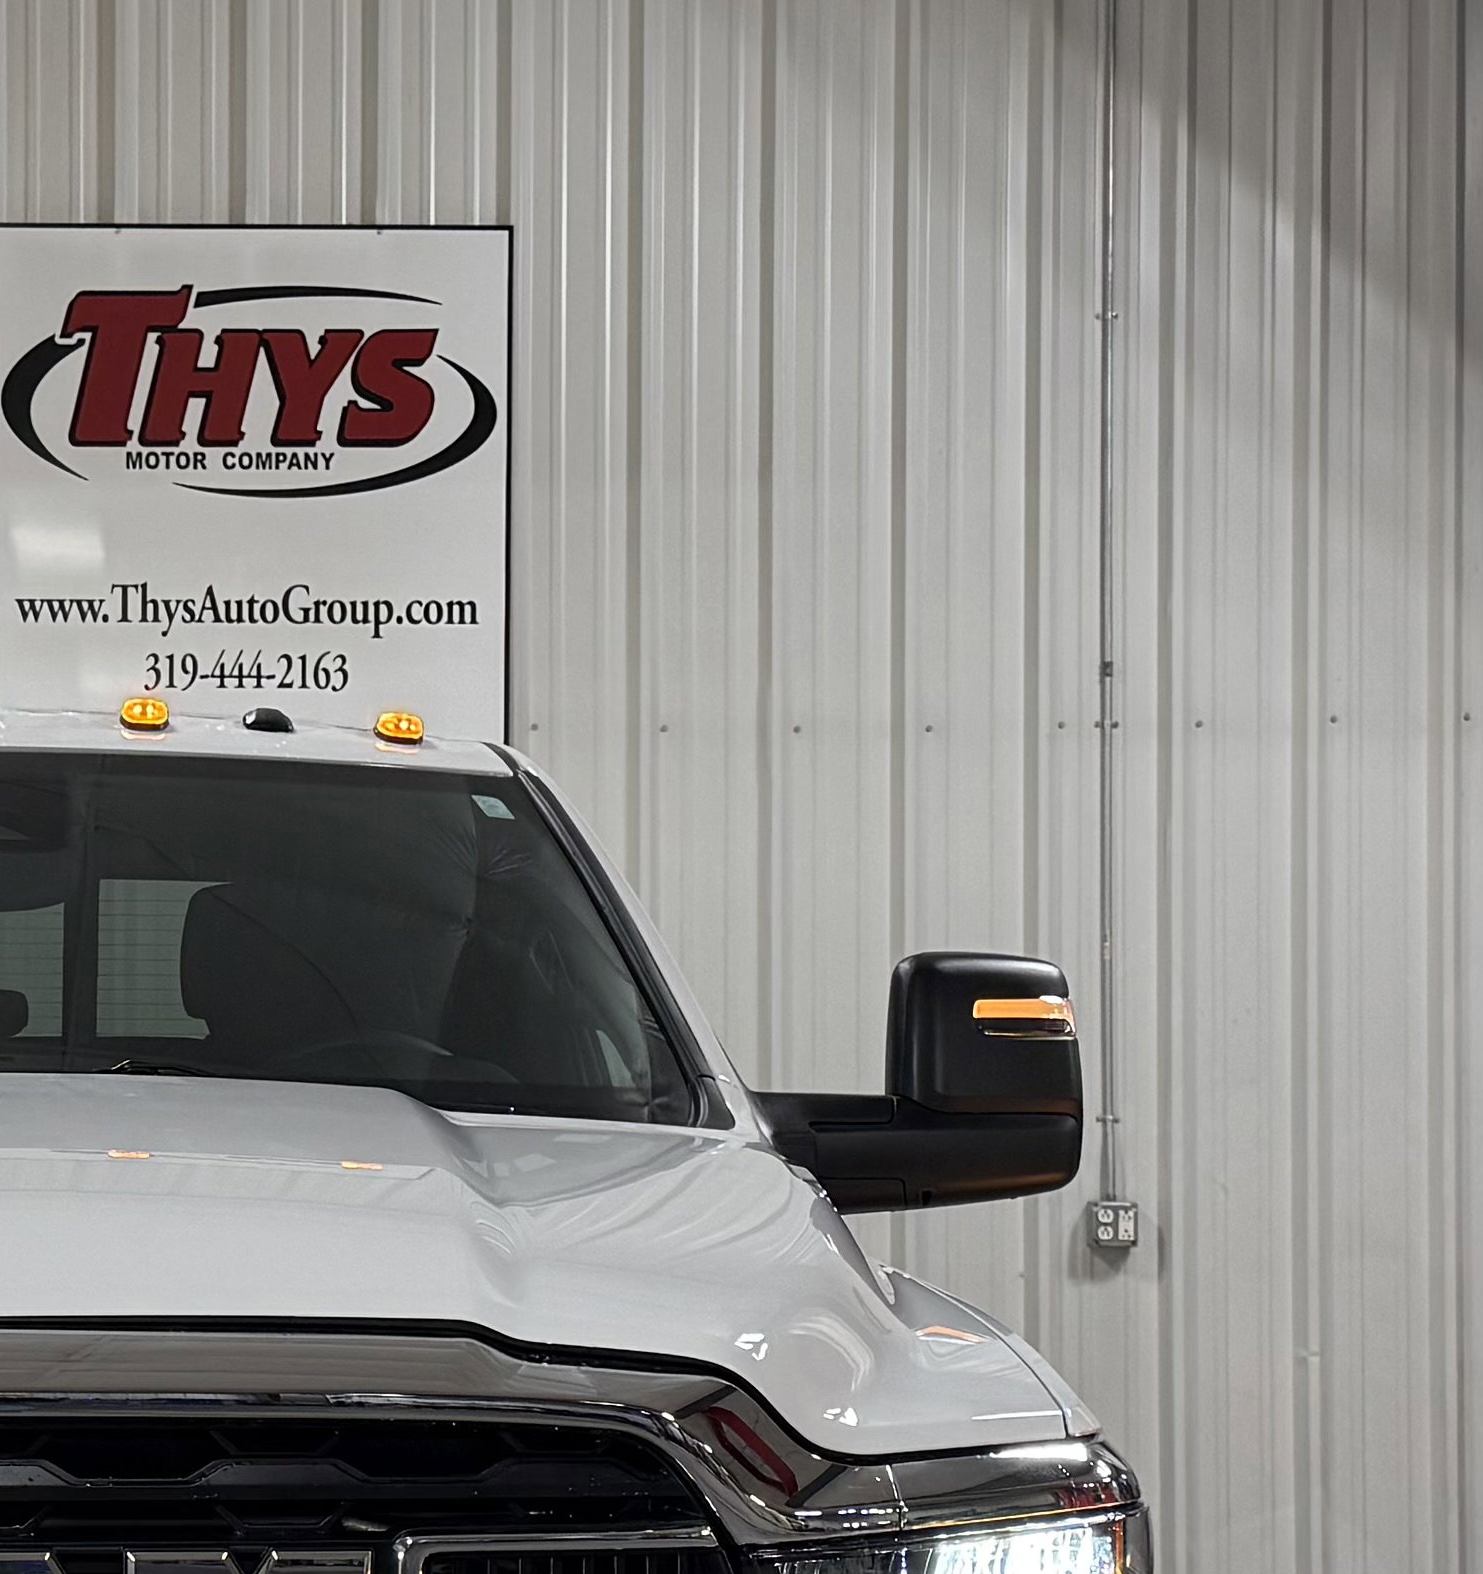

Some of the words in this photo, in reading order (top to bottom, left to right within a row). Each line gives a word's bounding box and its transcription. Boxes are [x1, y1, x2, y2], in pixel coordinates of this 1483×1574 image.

[61, 284, 439, 448] THYS
[125, 451, 207, 470] MOTOR
[222, 451, 335, 471] COMPANY
[15, 582, 479, 638] www.ThysAutoGroup.com
[143, 649, 349, 691] 319-444-2163
